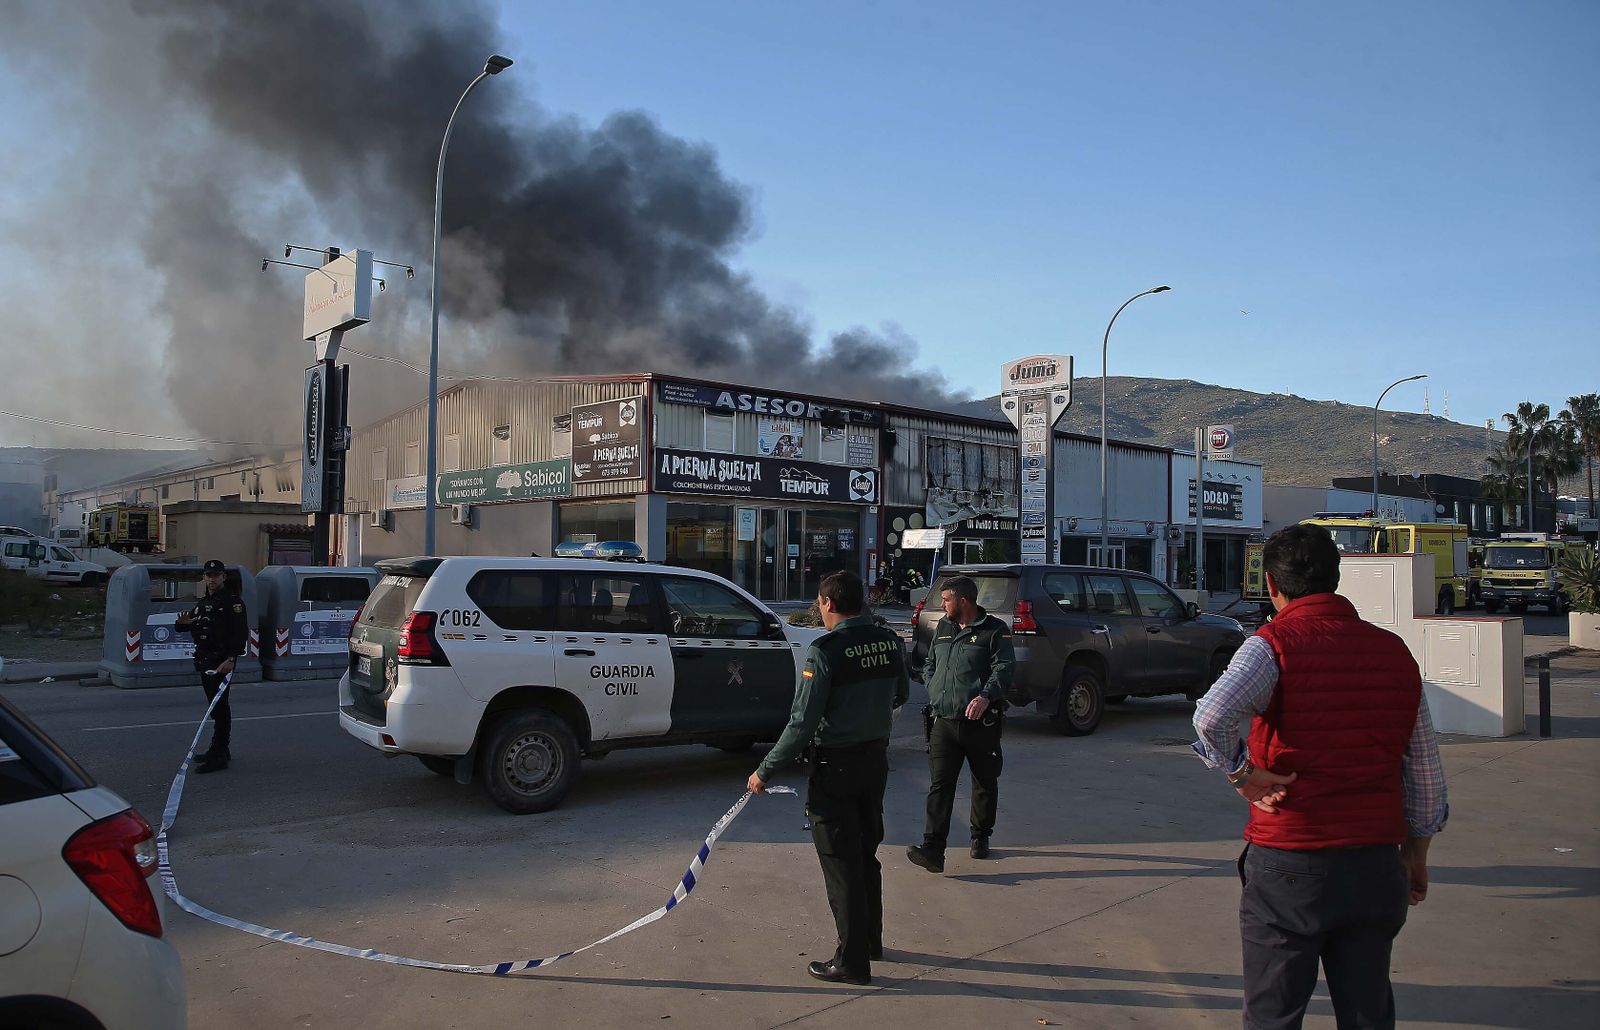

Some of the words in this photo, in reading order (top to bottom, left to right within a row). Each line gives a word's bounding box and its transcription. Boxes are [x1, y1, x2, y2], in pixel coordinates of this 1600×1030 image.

[1010, 364, 1056, 380] Juma
[578, 418, 603, 430] TEMPUR
[598, 447, 617, 462] PIERNA
[618, 444, 638, 461] SUELTA
[1028, 443, 1042, 453] 3M
[661, 454, 670, 474] A
[672, 455, 717, 480] PIERNA
[718, 460, 761, 482] SUELTA
[524, 466, 566, 487] Sabicol
[524, 486, 566, 495] COLCHONES
[780, 479, 829, 495] TEMPUR
[1204, 490, 1228, 505] DD&D
[993, 520, 998, 530] DE
[452, 609, 480, 626] 062
[845, 641, 897, 657] GUARDIA
[861, 654, 890, 668] CIVIL
[590, 665, 655, 678] GUARDIA
[605, 683, 638, 695] CIVIL
